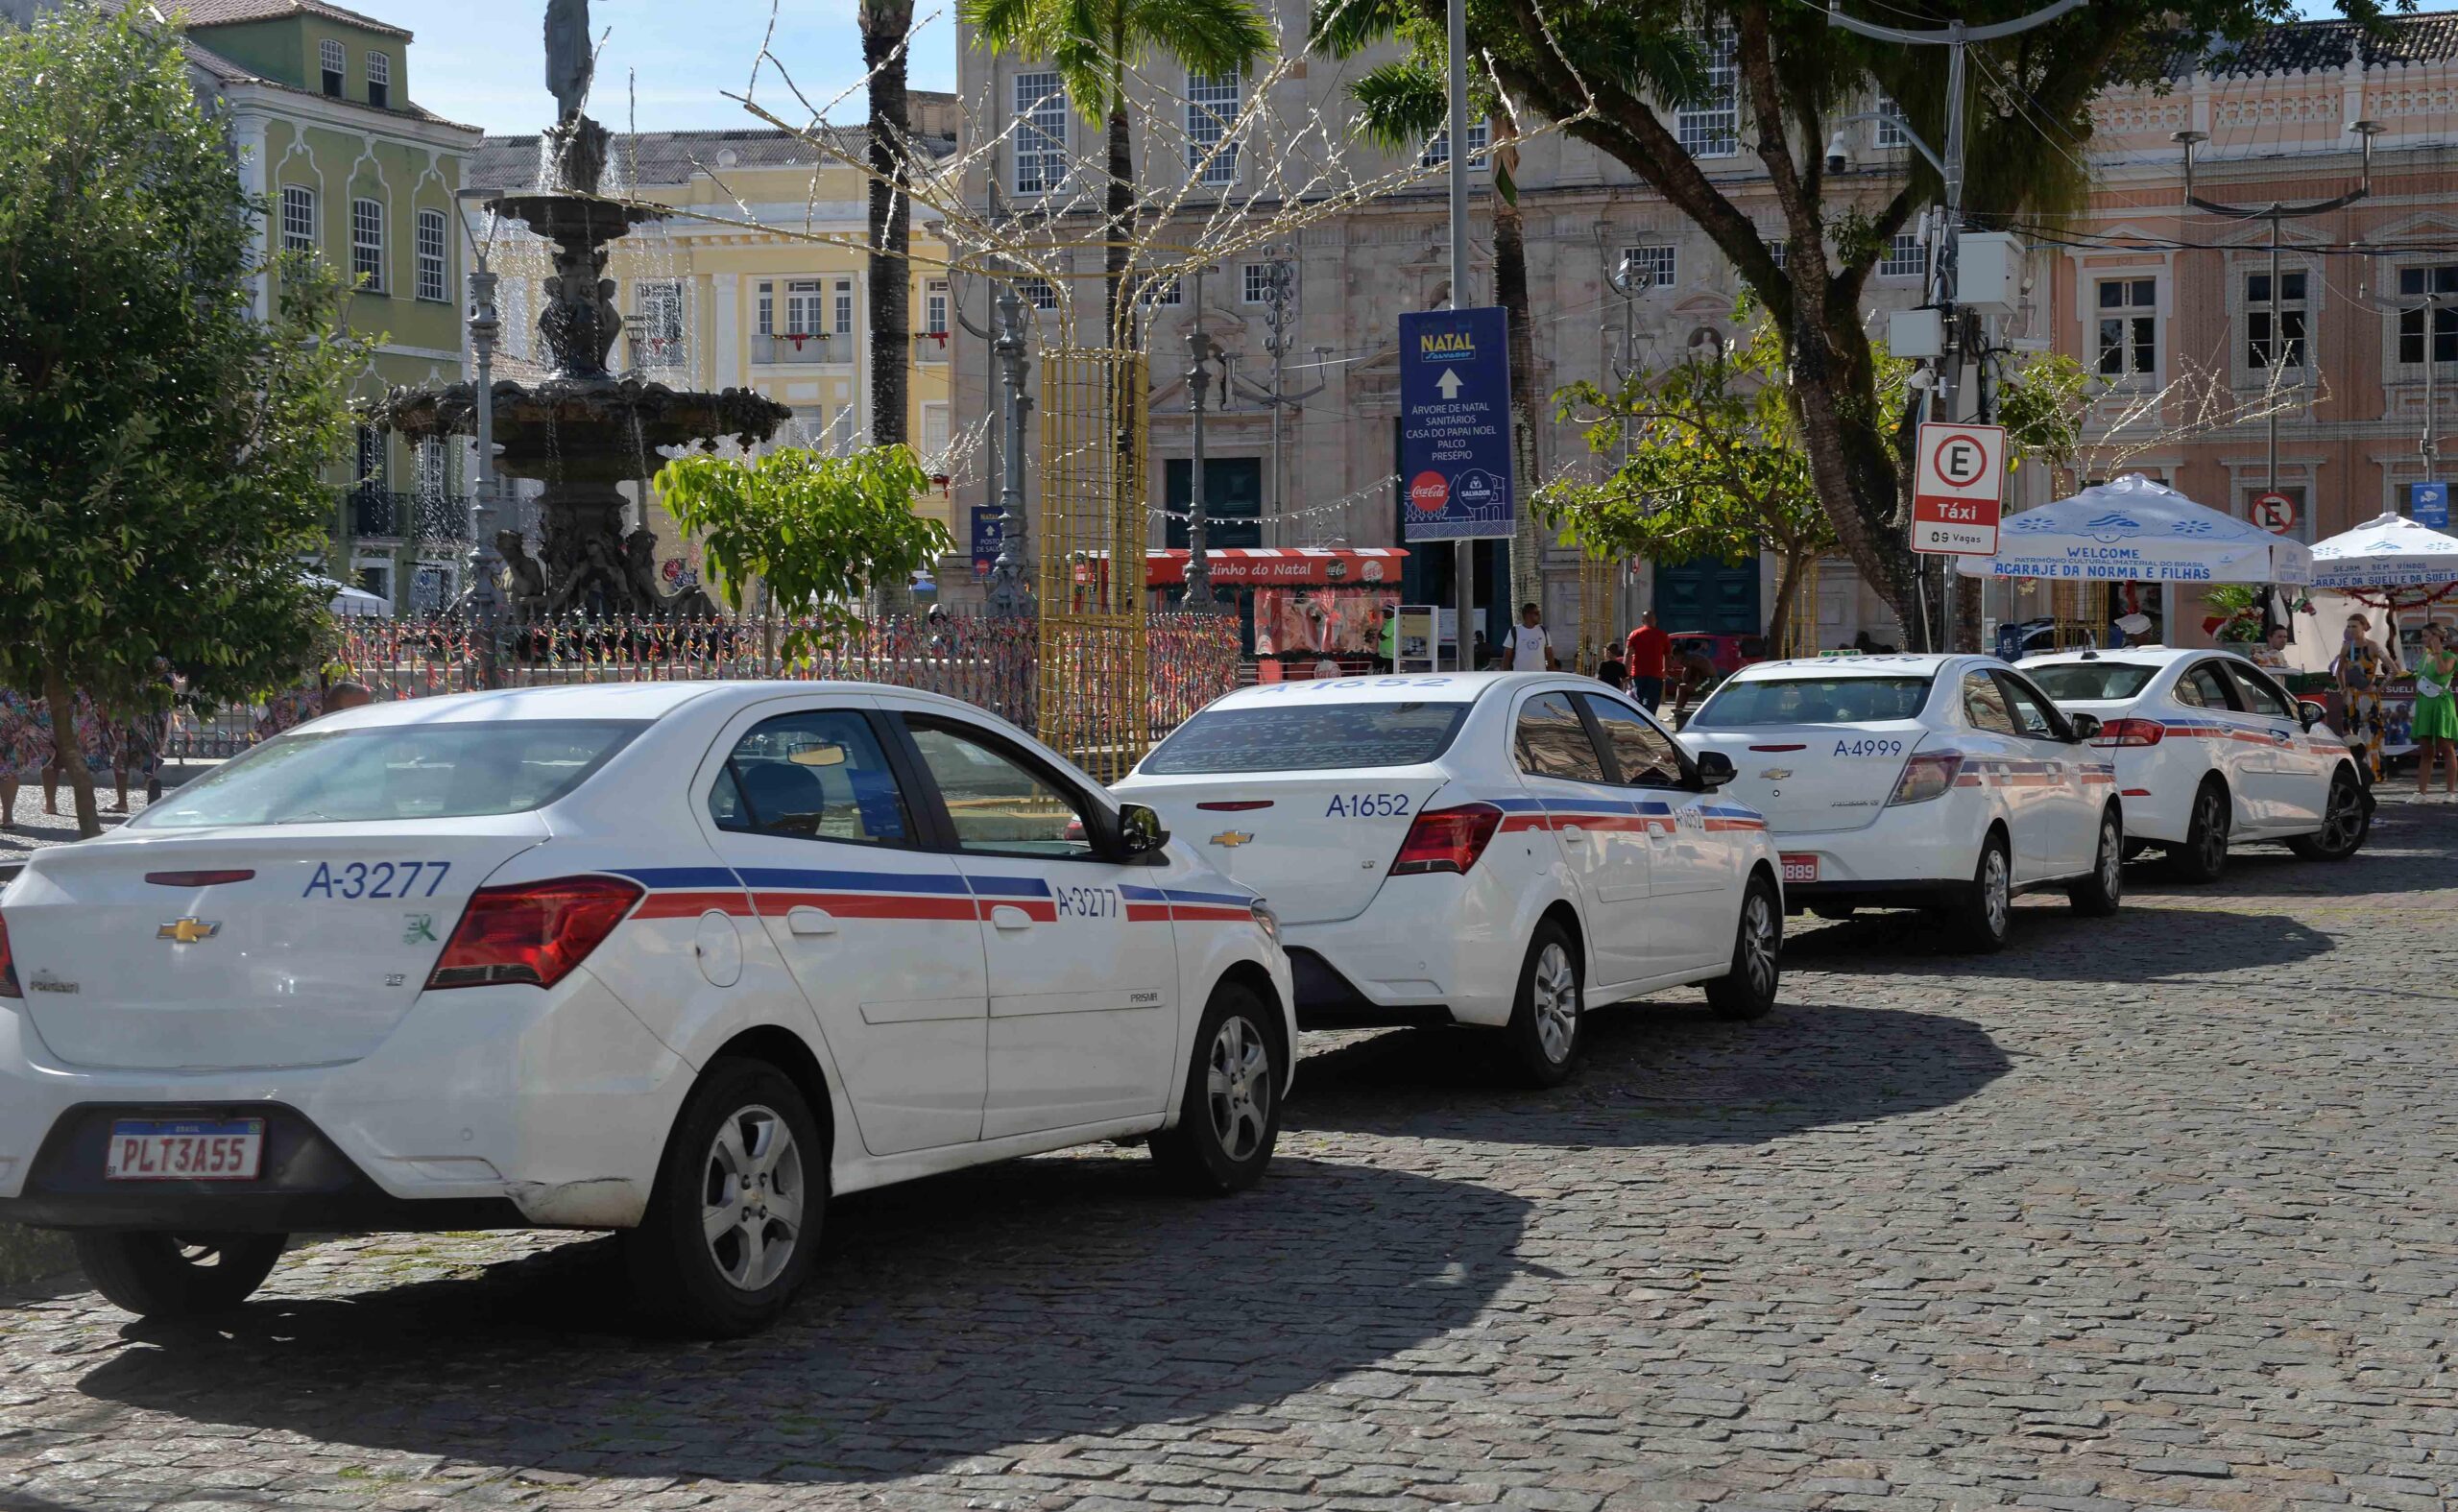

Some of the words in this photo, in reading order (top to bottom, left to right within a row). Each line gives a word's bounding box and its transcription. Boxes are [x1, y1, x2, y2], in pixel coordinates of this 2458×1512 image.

[1421, 333, 1475, 352] NATAL
[1411, 404, 1447, 415] ÁRVORE
[1449, 404, 1460, 413] DE
[1462, 402, 1490, 412] NATAL
[1426, 415, 1477, 426] SANITÁRIOS
[1406, 429, 1430, 439] CASA
[1432, 428, 1445, 438] DO
[1447, 427, 1471, 437] PAPAI
[1473, 425, 1497, 436] NOEL
[1437, 439, 1466, 448] PALCO
[1432, 450, 1473, 461] PRESÉPIO
[1950, 446, 1970, 476] E
[1938, 502, 1977, 520] Táxi
[1931, 531, 1949, 543] 09
[1953, 533, 1982, 544] Vagas
[2014, 556, 2066, 564] PATRIMÔNIO
[2067, 547, 2140, 560] WELCOME
[1252, 563, 1268, 576] do
[1274, 562, 1312, 576] Natal
[2064, 565, 2080, 576] DA
[2087, 565, 2138, 578] NORMA
[2146, 566, 2154, 578] E
[2161, 567, 2210, 580] FILHAS
[2333, 564, 2360, 573] SEJAM
[2351, 576, 2363, 585] DA
[2401, 575, 2407, 584] E
[2410, 574, 2422, 583] DA
[1257, 678, 1453, 695] A-1652
[1833, 740, 1902, 757] A-4999
[1326, 794, 1410, 817] A-1652
[303, 861, 451, 900] A-3277
[1057, 886, 1117, 918] A-3277
[1130, 992, 1158, 1002] PRISMA
[122, 1138, 246, 1172] PLT3A55
